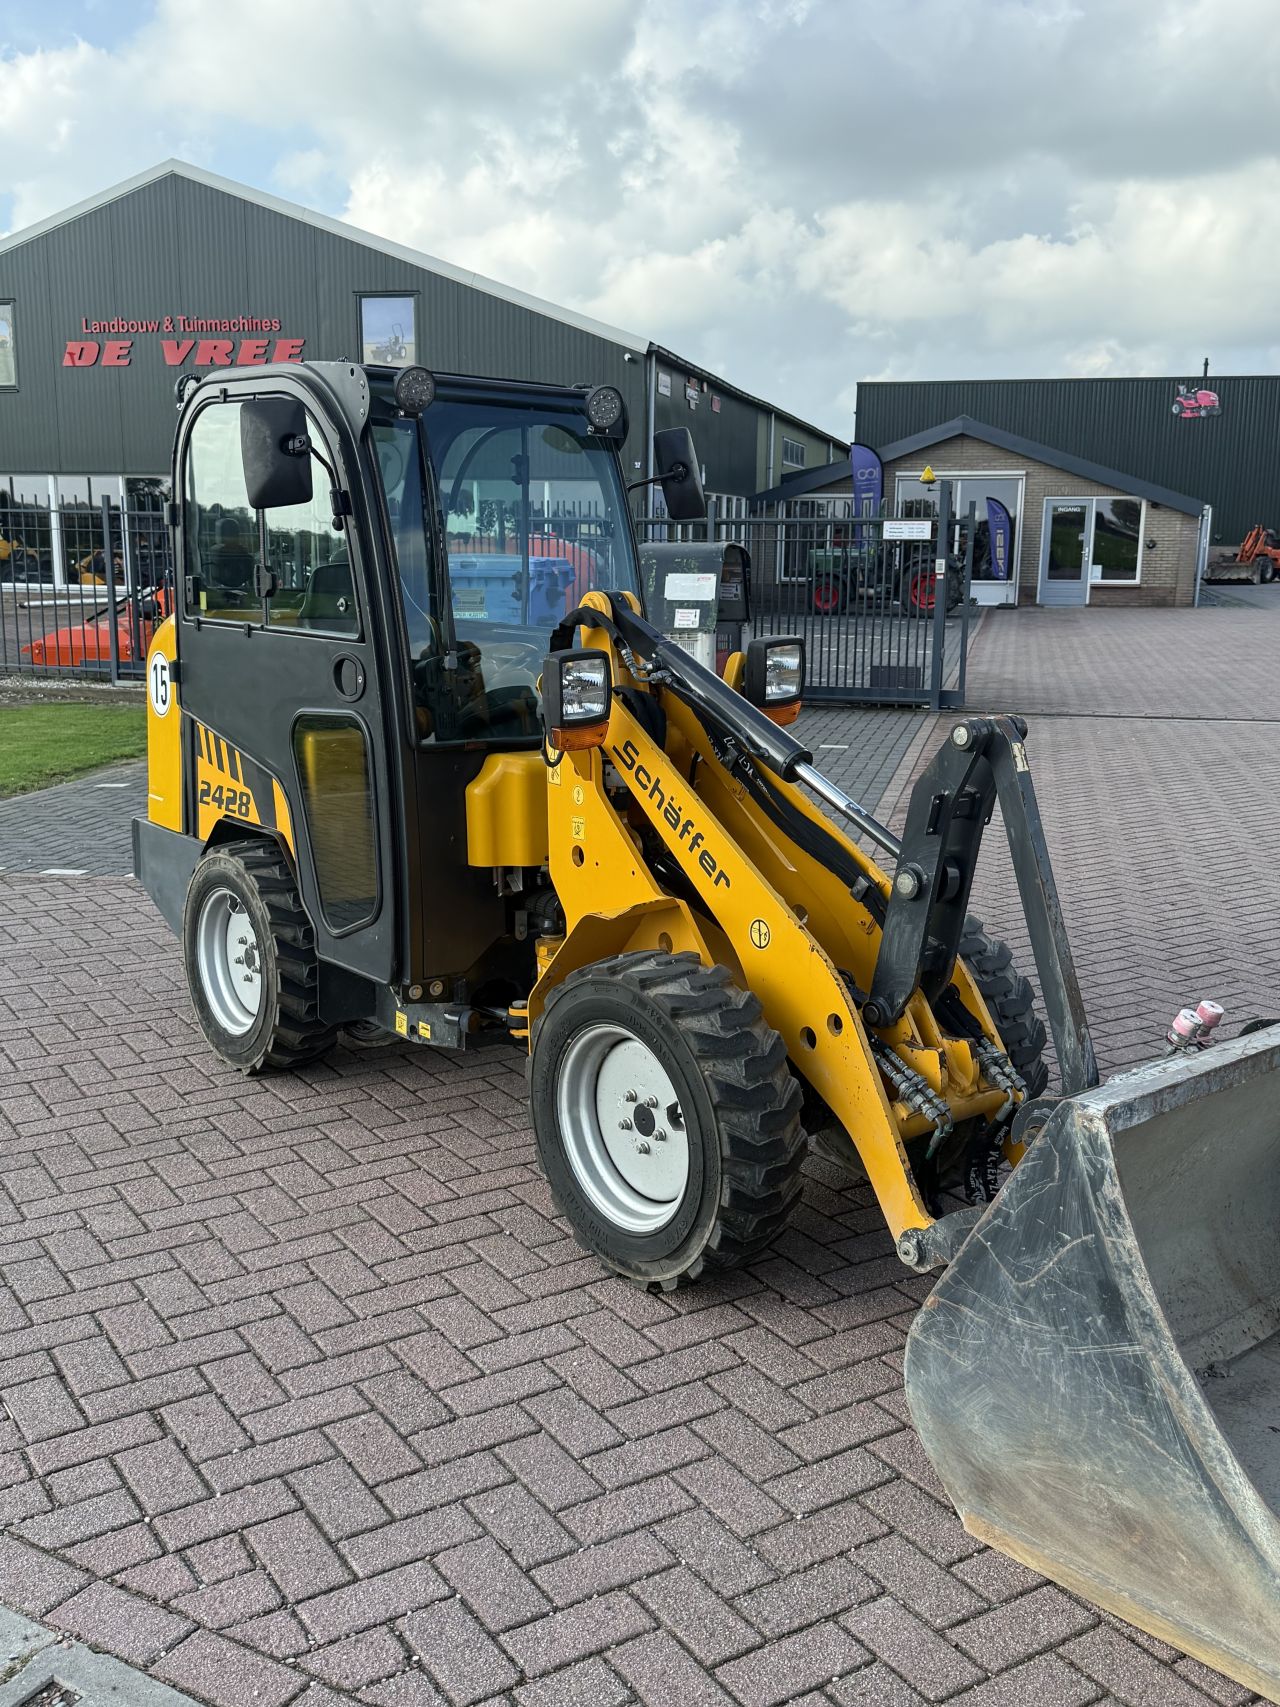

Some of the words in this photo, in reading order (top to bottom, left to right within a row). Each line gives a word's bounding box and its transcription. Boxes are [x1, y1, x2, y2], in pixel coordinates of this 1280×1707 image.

[81, 317, 159, 334] Landbouw
[163, 316, 174, 333] &
[177, 315, 281, 333] Tuinmachines
[62, 340, 133, 367] DE
[160, 338, 306, 367] VREE
[153, 663, 168, 706] 15
[199, 780, 251, 818] 2428
[612, 739, 731, 889] Schäffer
